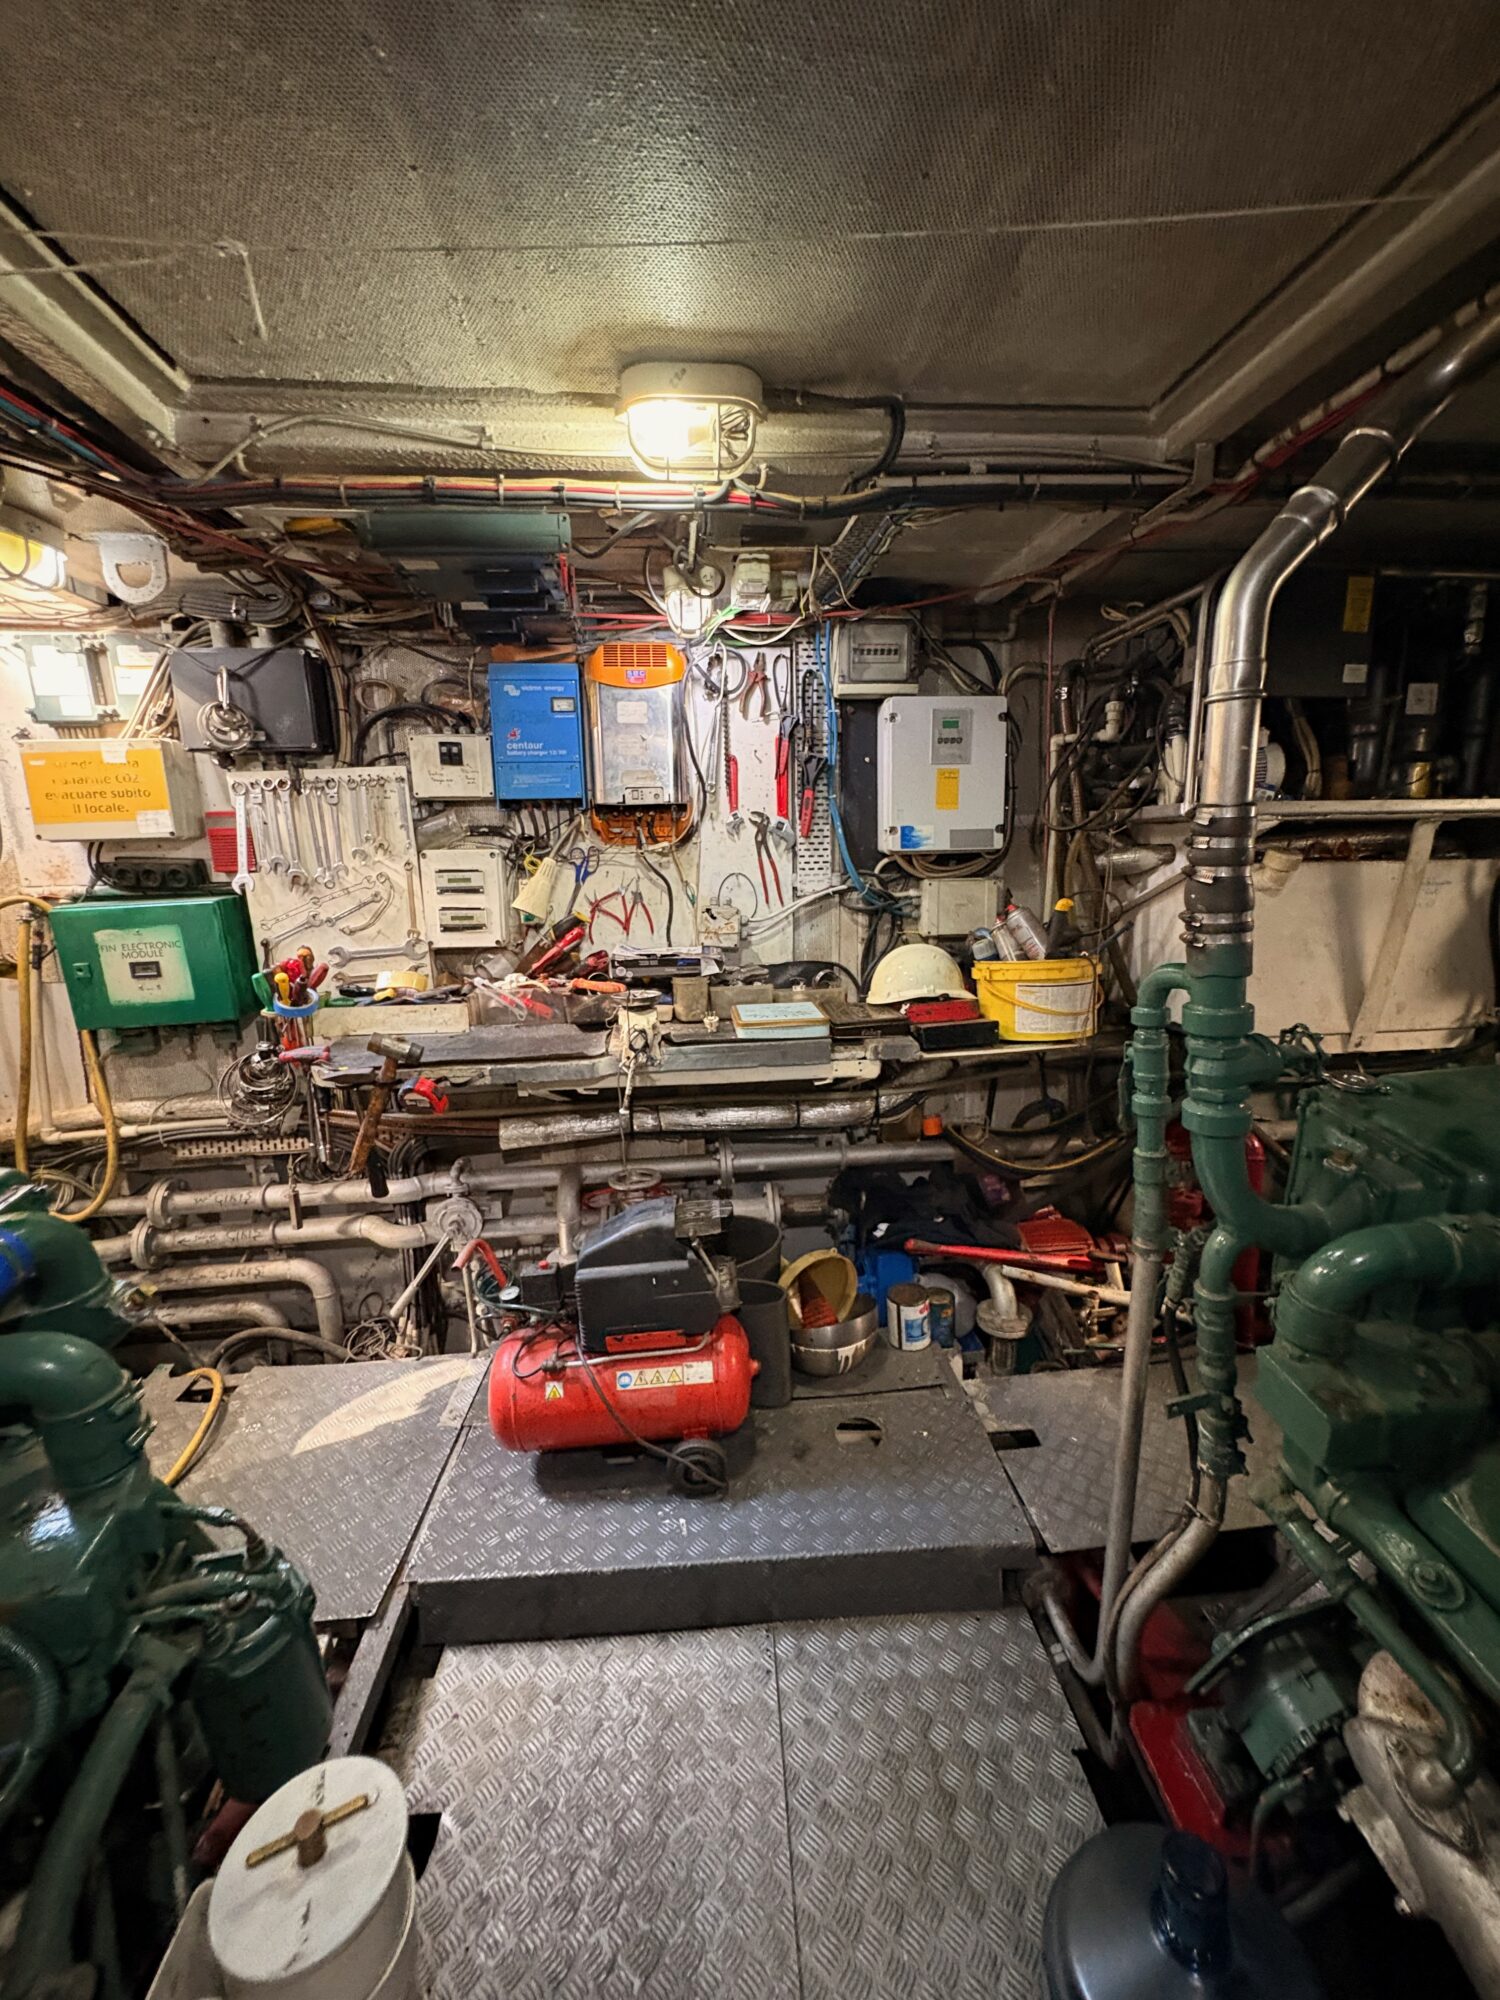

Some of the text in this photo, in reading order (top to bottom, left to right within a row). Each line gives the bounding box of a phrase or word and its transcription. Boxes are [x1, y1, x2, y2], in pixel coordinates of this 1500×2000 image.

[506, 741, 544, 750] centaur
[110, 788, 151, 799] subito
[85, 803, 129, 814] locale.
[100, 941, 182, 952] FIN ELECTRONIC
[121, 949, 164, 960] MODULE
